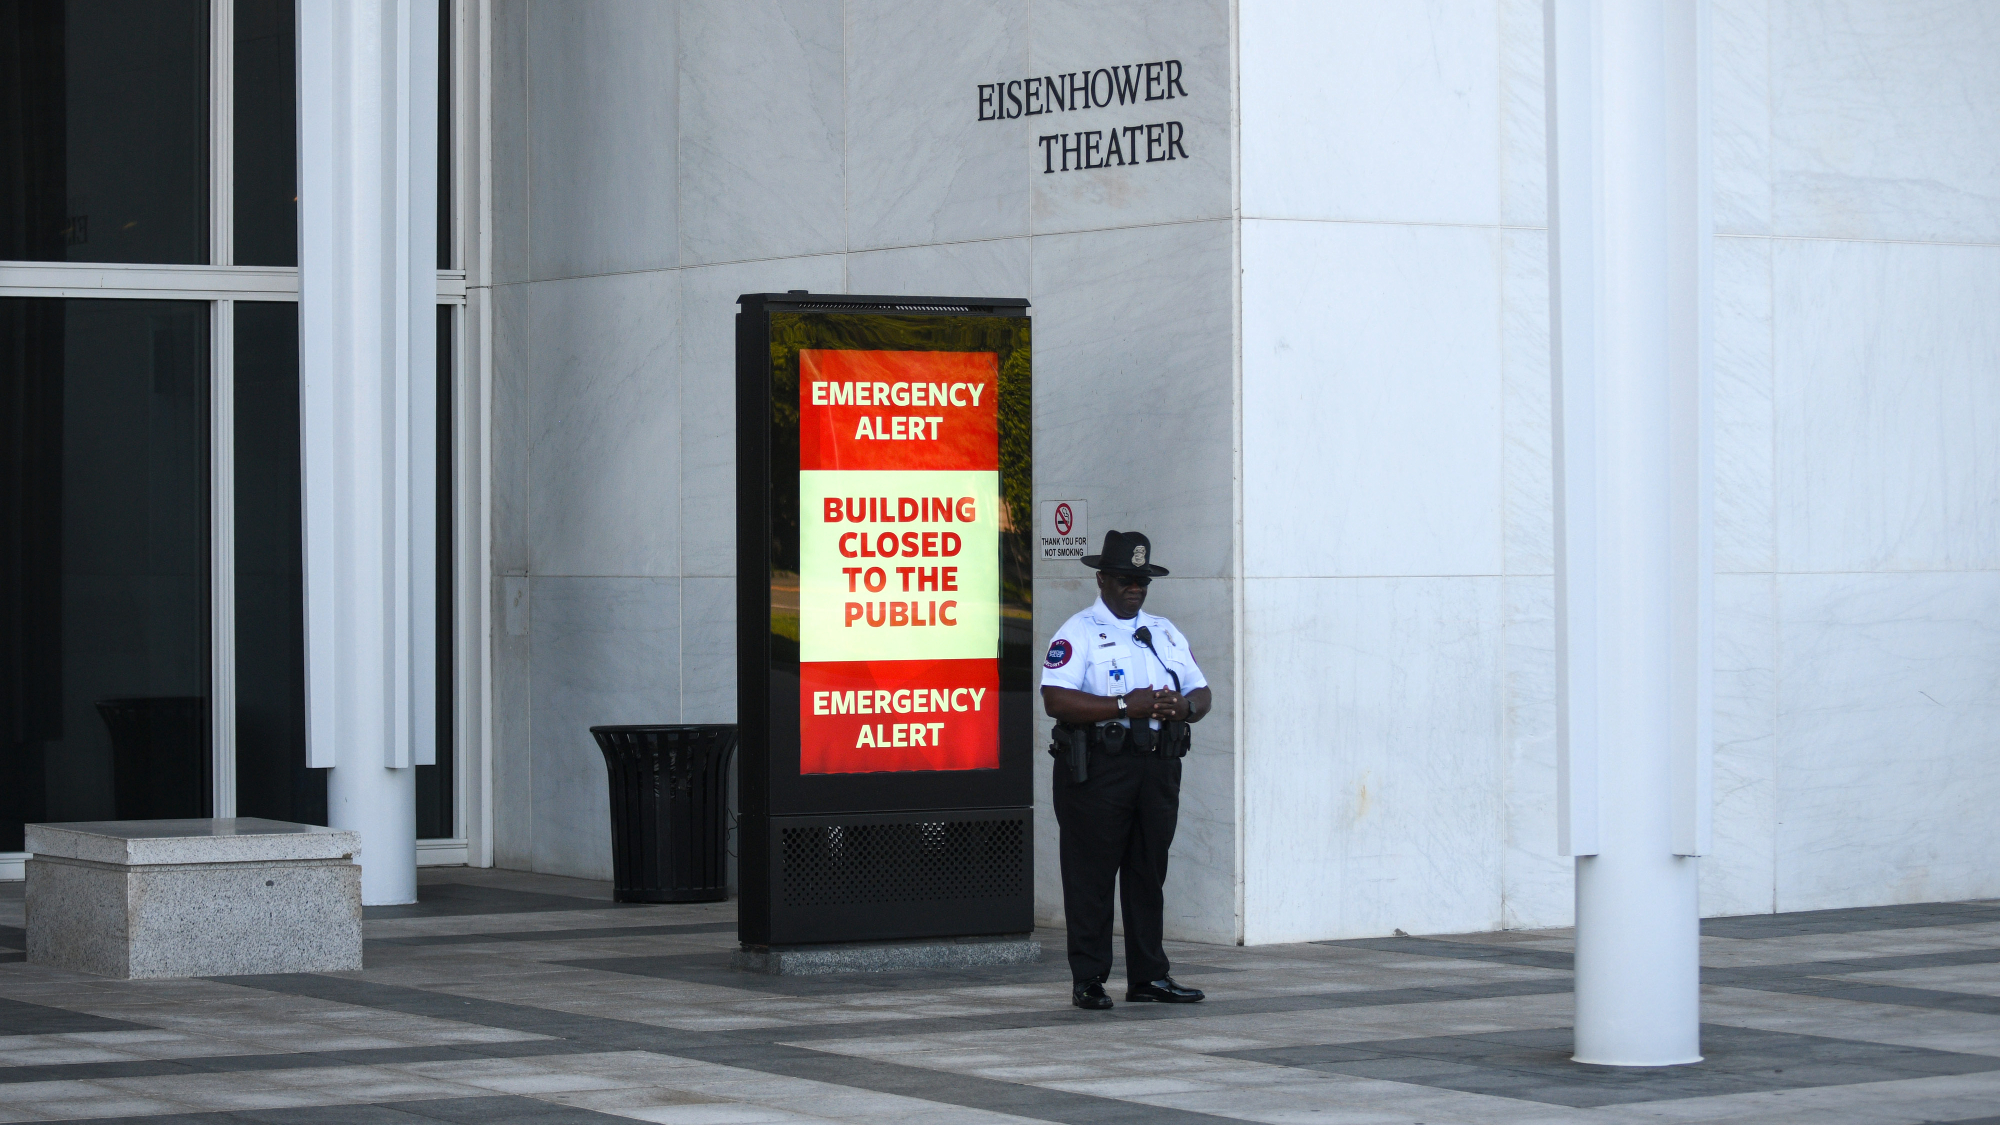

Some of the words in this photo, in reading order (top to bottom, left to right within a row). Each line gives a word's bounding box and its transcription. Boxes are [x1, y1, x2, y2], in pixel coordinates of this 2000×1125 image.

[977, 59, 1188, 121] EISENHOWER
[1038, 121, 1189, 174] THEATER
[811, 381, 985, 407] EMERGENCY
[854, 416, 944, 441] ALERT
[823, 496, 976, 523] BUILDING
[838, 531, 962, 558] CLOSED
[1042, 537, 1061, 546] THANK
[1062, 537, 1074, 546] YOU
[1074, 537, 1087, 546] FOR
[1044, 548, 1056, 556] NOT
[1057, 548, 1084, 556] SMOKING
[842, 566, 887, 593] TO
[896, 566, 959, 592] THE
[844, 600, 958, 628] PUBLIC
[813, 687, 986, 716] EMERGENCY
[855, 723, 945, 749] ALERT
